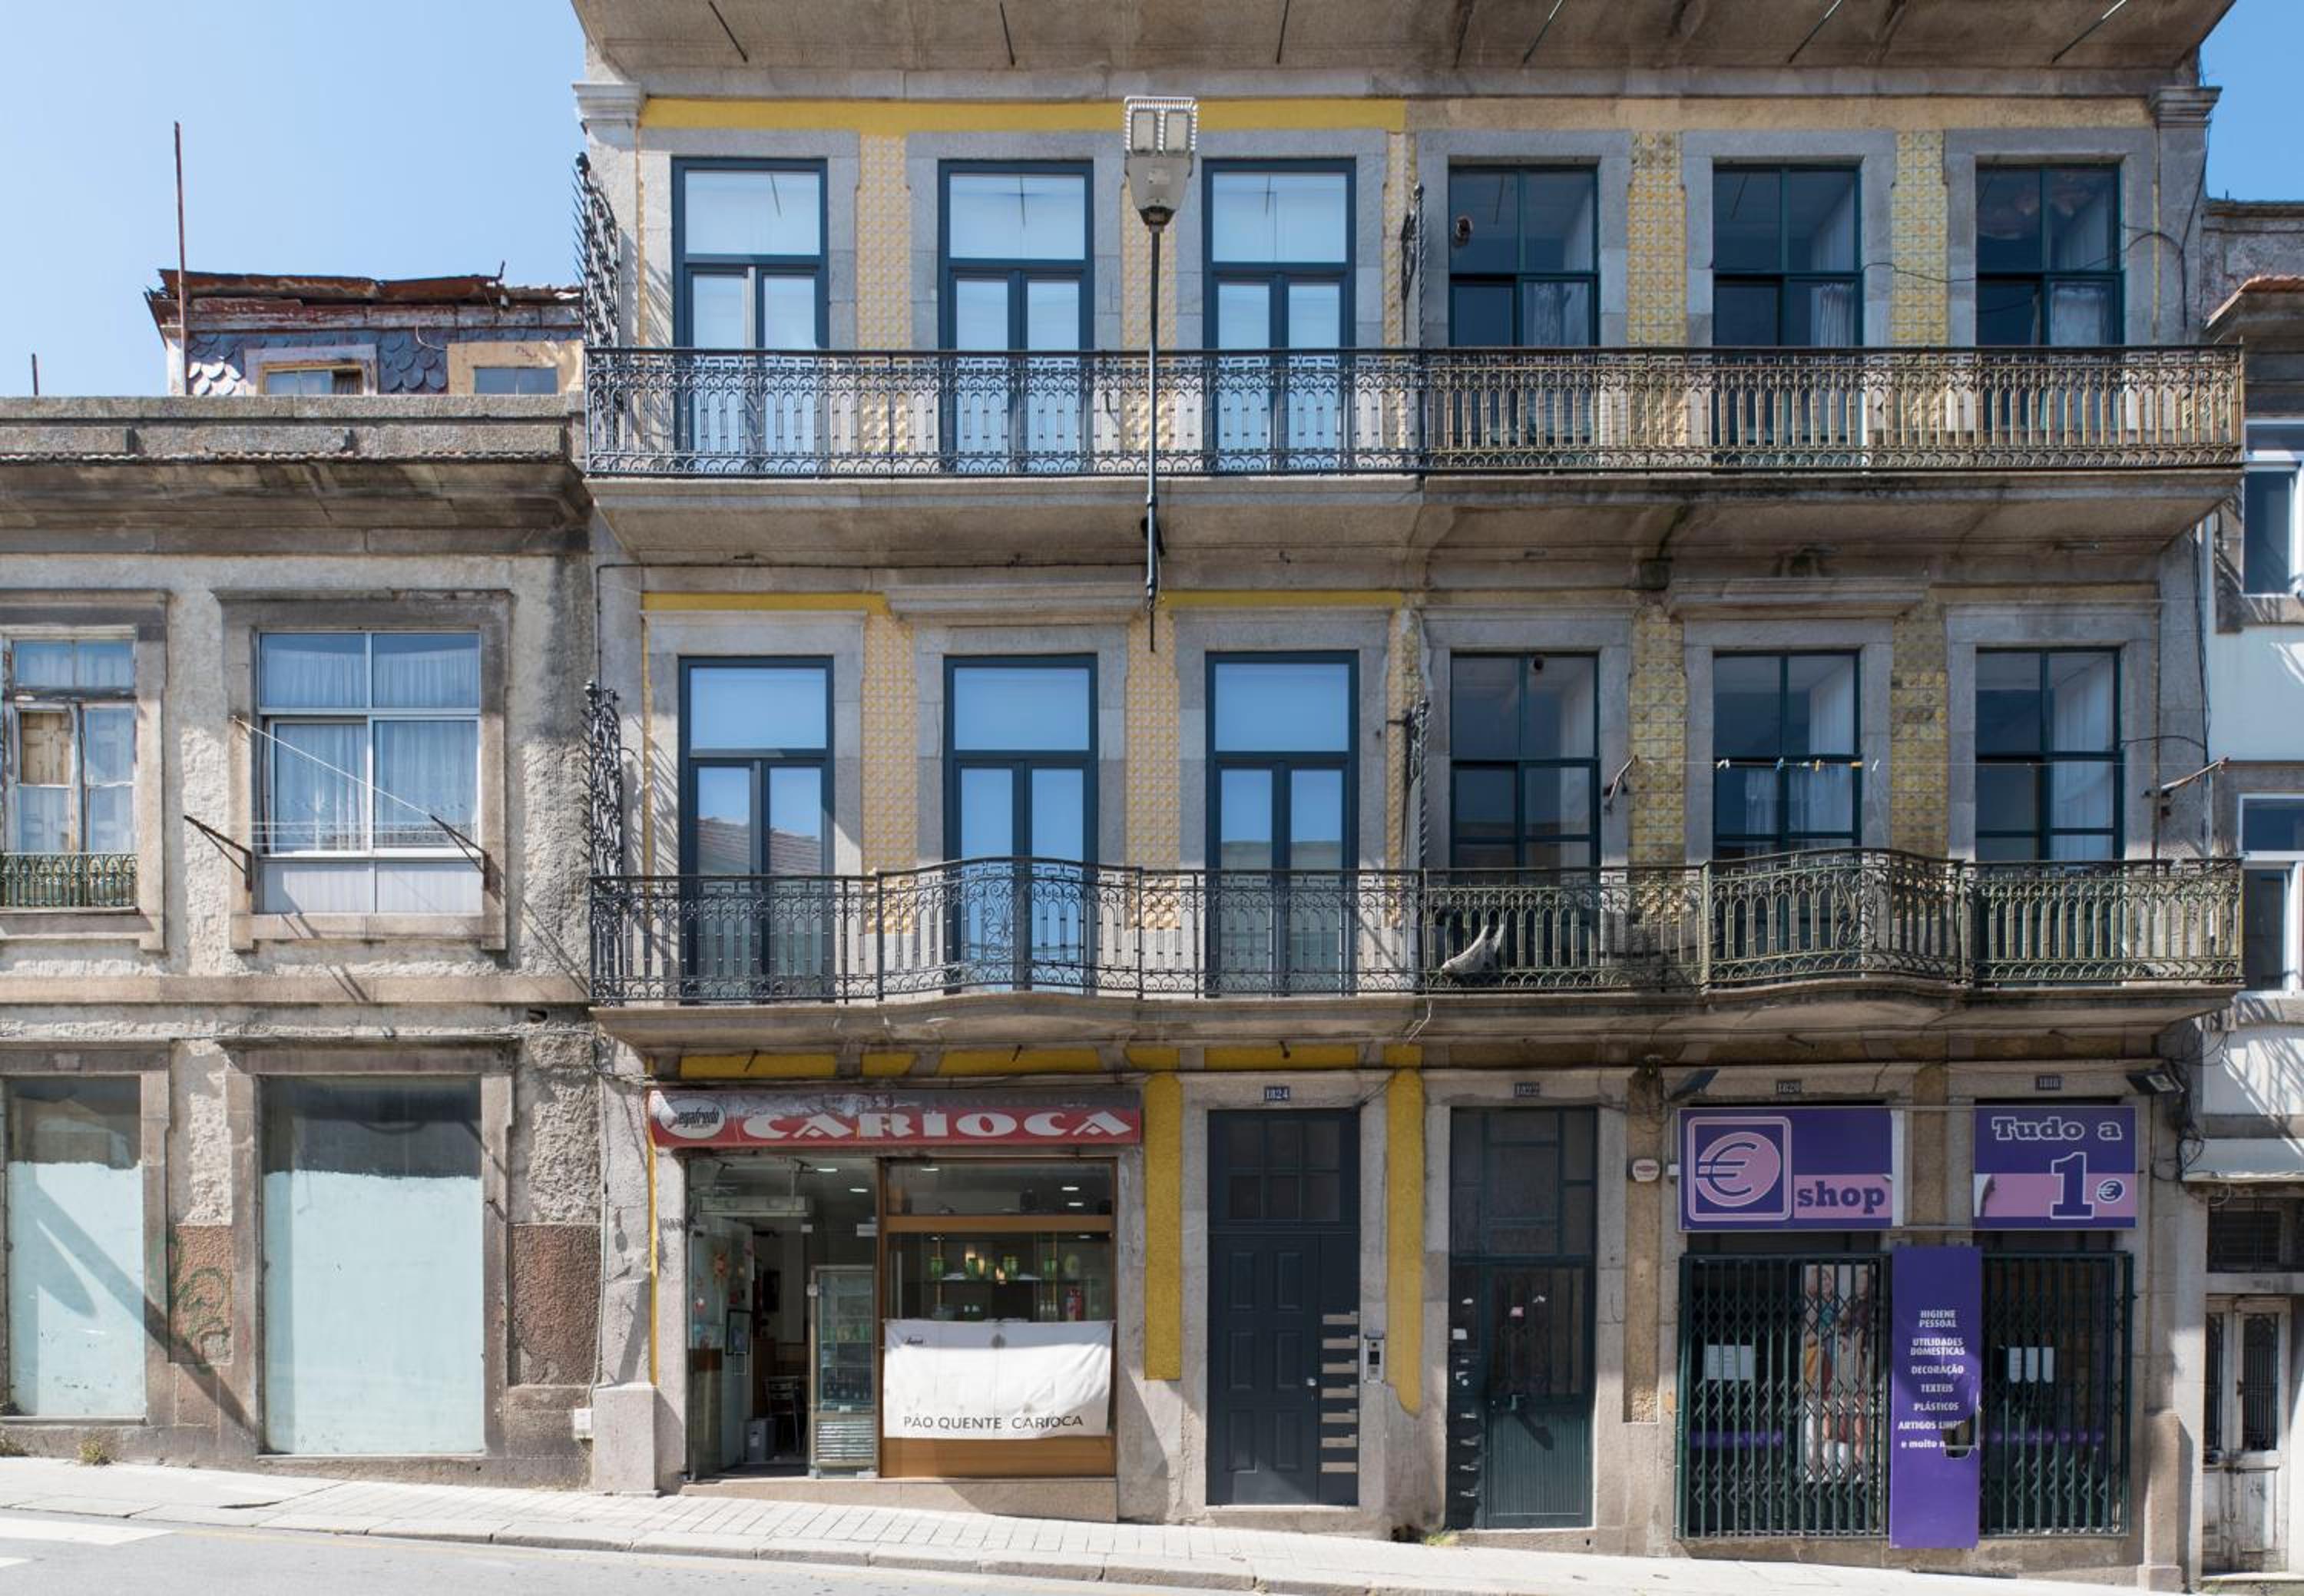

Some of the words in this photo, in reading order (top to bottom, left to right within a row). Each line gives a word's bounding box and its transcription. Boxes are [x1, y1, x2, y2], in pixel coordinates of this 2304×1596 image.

[743, 1111, 1132, 1139] CARIOCA
[1991, 1116, 2085, 1141] Tudo
[2097, 1121, 2122, 1141] a
[1796, 1180, 1885, 1214] shop
[1920, 1310, 1955, 1319] HIGIENE
[1918, 1320, 1957, 1328] PESSOAL
[1912, 1337, 1964, 1346] UTILIDADES
[1911, 1364, 1964, 1376] DECORAÇÃO
[1913, 1401, 1960, 1411] PLÁSTICOS
[938, 1416, 1002, 1429] QUENTE
[1011, 1416, 1084, 1429] CARIOCA
[1898, 1420, 1936, 1430] ARTIGOS
[1908, 1439, 1938, 1448] muito
